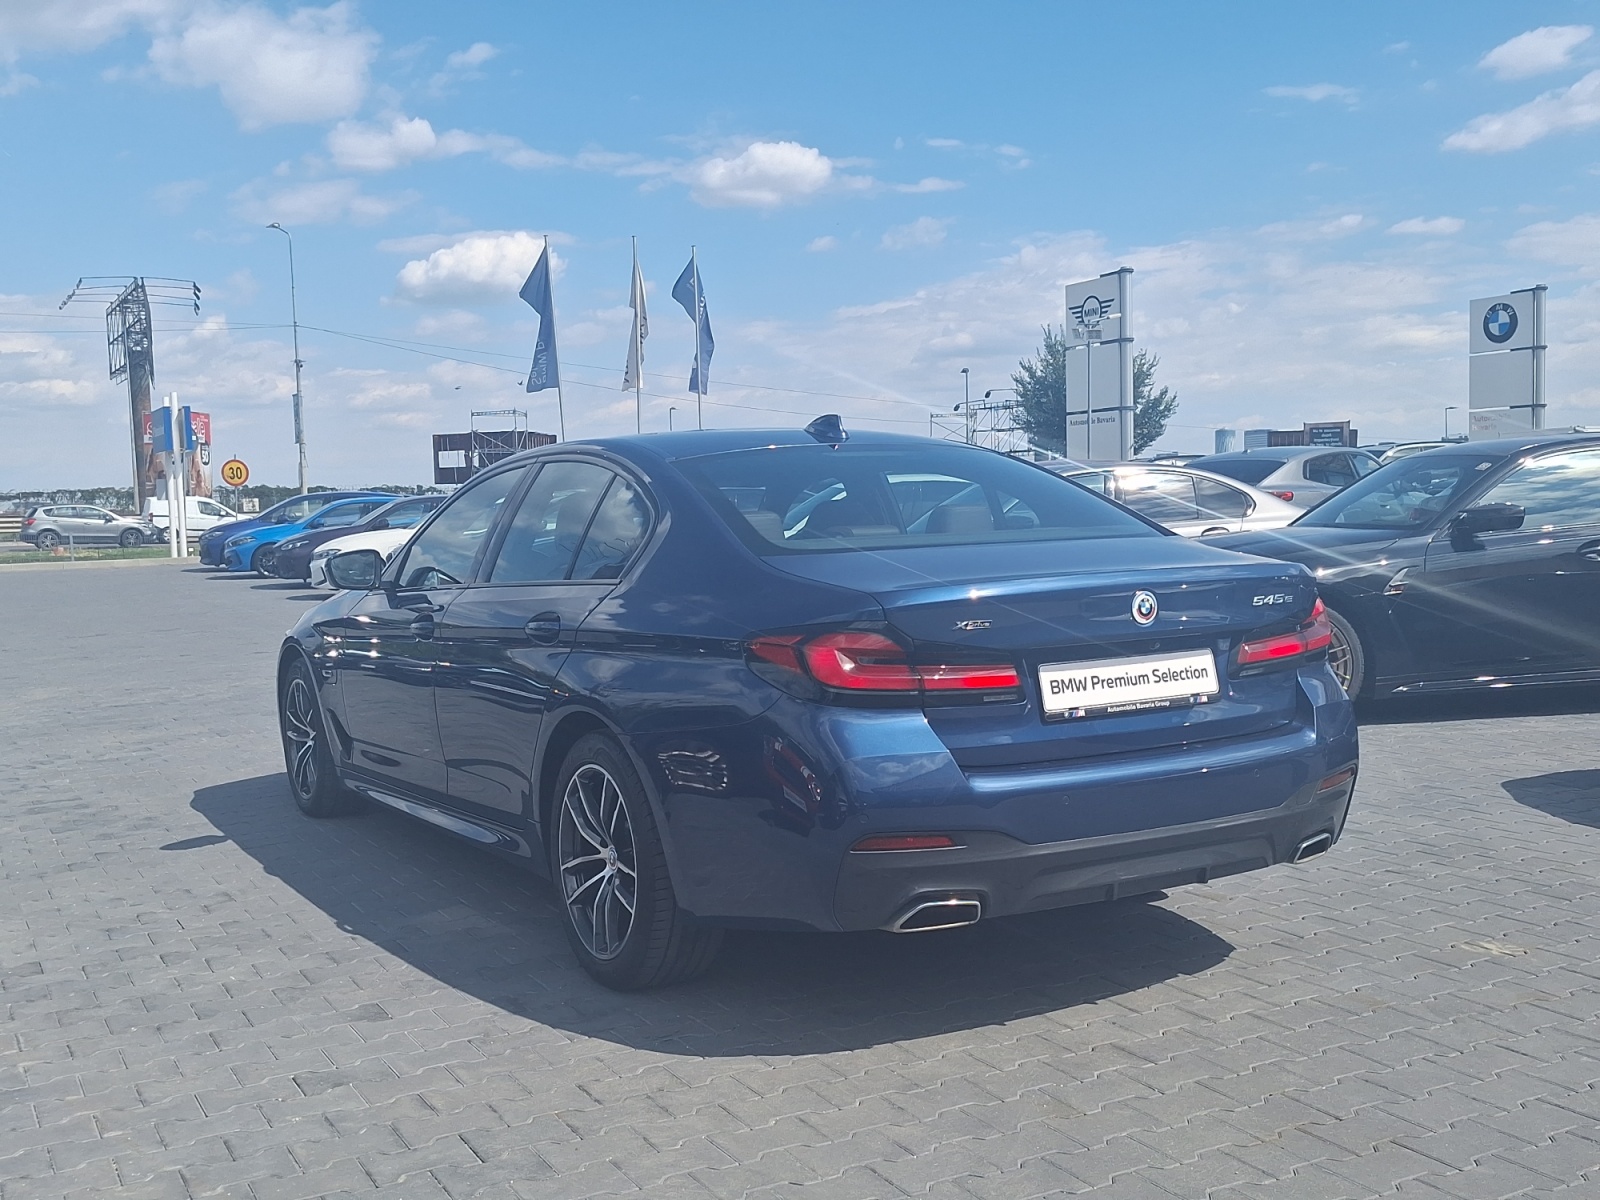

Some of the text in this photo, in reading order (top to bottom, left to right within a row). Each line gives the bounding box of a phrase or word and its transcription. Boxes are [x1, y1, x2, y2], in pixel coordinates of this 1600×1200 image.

[1084, 307, 1099, 317] MINI
[228, 466, 243, 480] 30
[1049, 665, 1209, 695] BMW Premium Selection
[1155, 700, 1170, 708] Group
